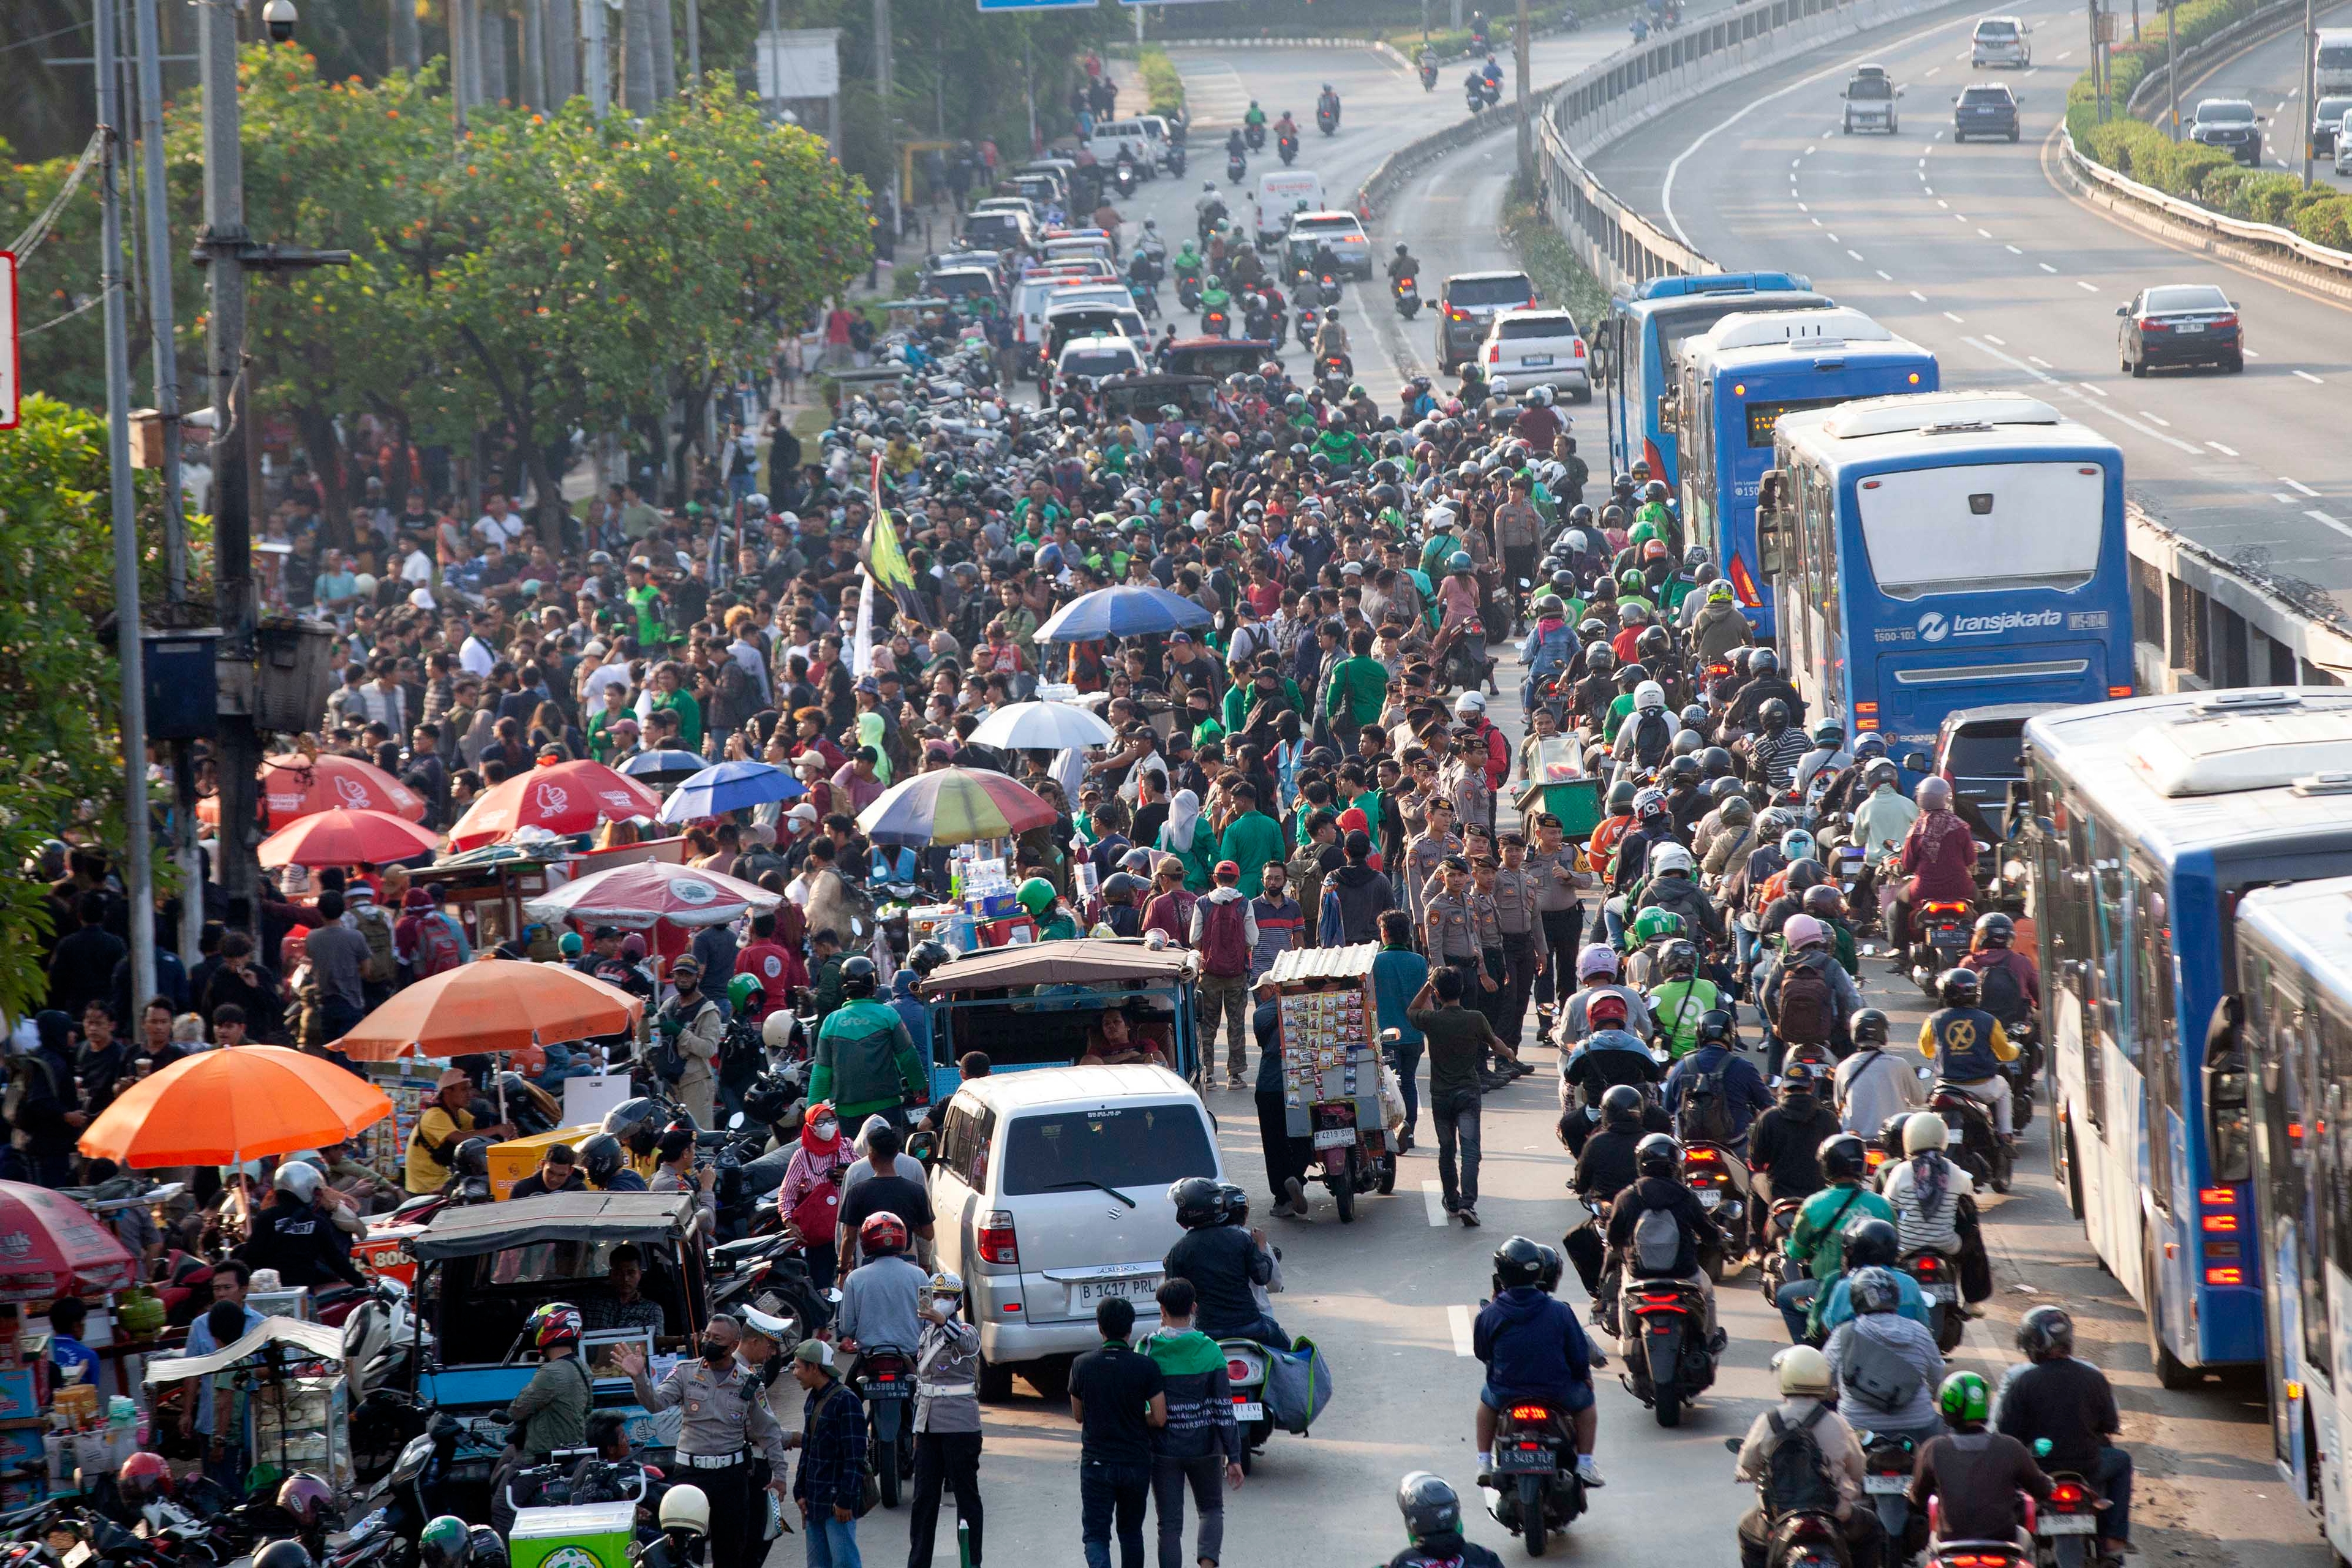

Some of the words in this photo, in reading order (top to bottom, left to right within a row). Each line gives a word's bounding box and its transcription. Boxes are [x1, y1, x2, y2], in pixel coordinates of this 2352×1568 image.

[1953, 609, 2062, 633] transjakarta
[1874, 631, 1916, 642] 1500-102
[1322, 1130, 1338, 1139] 4219
[1341, 1129, 1354, 1137] SUG
[1084, 1287, 1090, 1298] B
[1096, 1282, 1126, 1297] 1417
[1133, 1279, 1156, 1294] PRL
